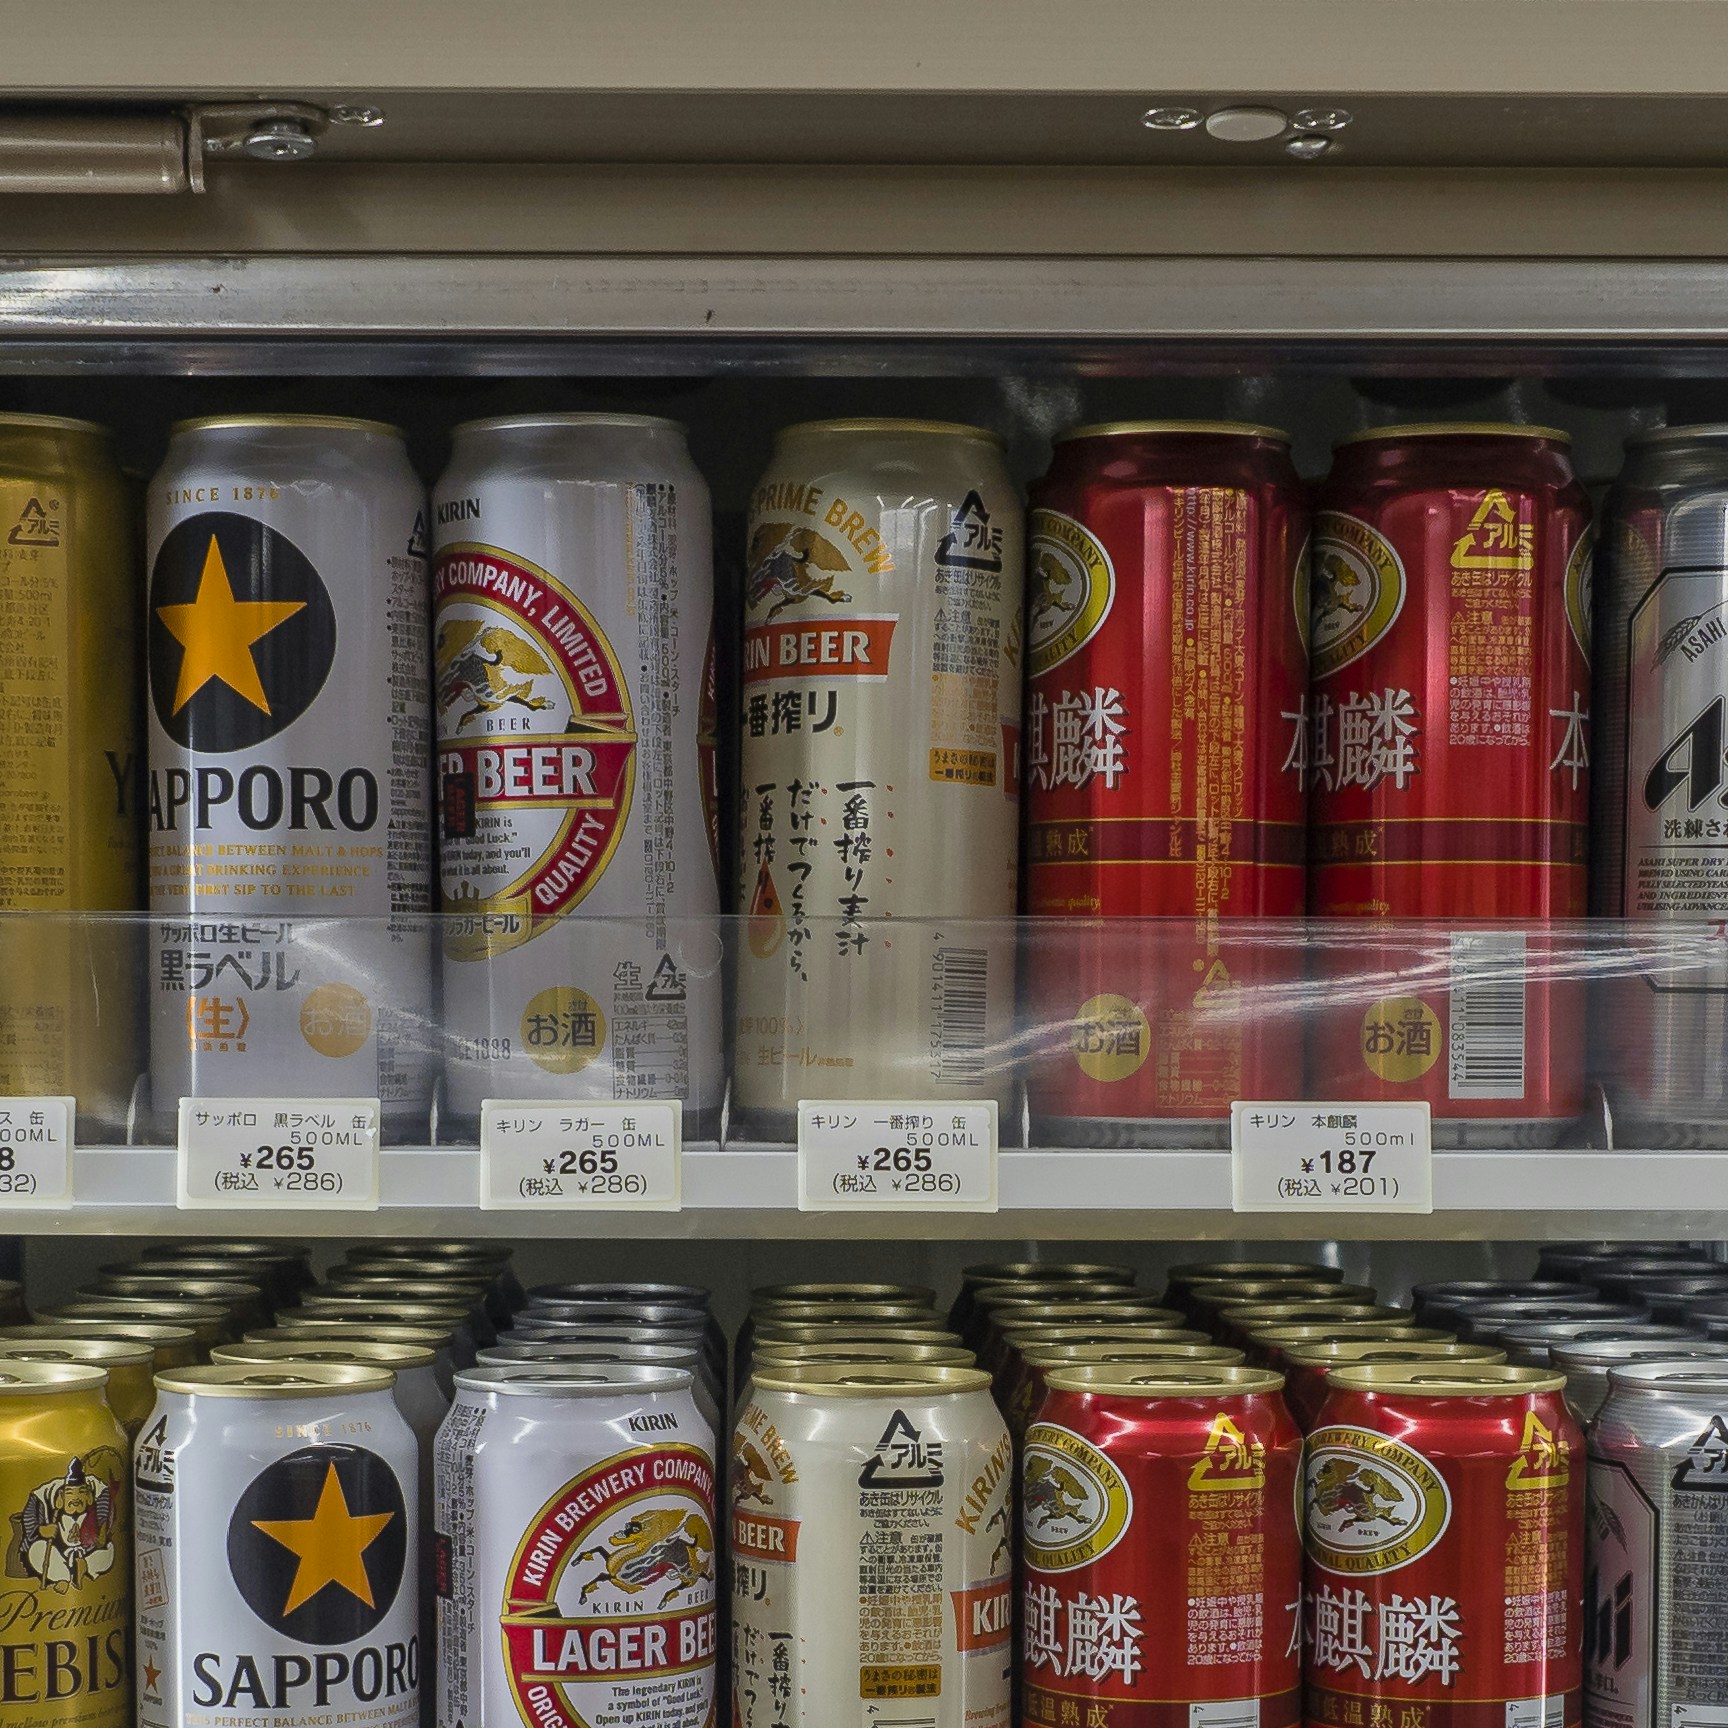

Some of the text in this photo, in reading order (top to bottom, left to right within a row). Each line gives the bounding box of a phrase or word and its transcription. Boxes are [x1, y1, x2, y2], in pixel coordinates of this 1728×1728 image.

[436, 498, 481, 526] KIRIN
[822, 500, 897, 575] BREW
[778, 631, 872, 664] BEER
[1680, 618, 1728, 664] ASAHI
[477, 747, 599, 797] BEER
[534, 812, 606, 908] QUALITY
[832, 780, 877, 958] 一番搾り麦汁
[160, 922, 298, 946] サッポロ生ビール
[159, 950, 301, 992] 黒ラベル
[526, 1010, 598, 1048] お酒
[1363, 1018, 1434, 1058] お酒
[29, 1110, 45, 1126] 缶
[195, 1111, 367, 1129] サッポロ 黒ラベル 缶
[496, 1117, 637, 1134] キリン ラガー 缶
[811, 1114, 967, 1130] キリン 一番搾り 缶
[1344, 1131, 1414, 1146] 500ml
[239, 1145, 315, 1171] ¥265
[542, 1149, 619, 1175] ¥265
[856, 1147, 933, 1173] ¥265
[1300, 1149, 1377, 1175] ¥187
[628, 1413, 678, 1432] KIRIN
[859, 1490, 943, 1508] あき缶はリサイクル
[738, 1528, 786, 1554] BEER
[532, 1628, 666, 1670] LAGER
